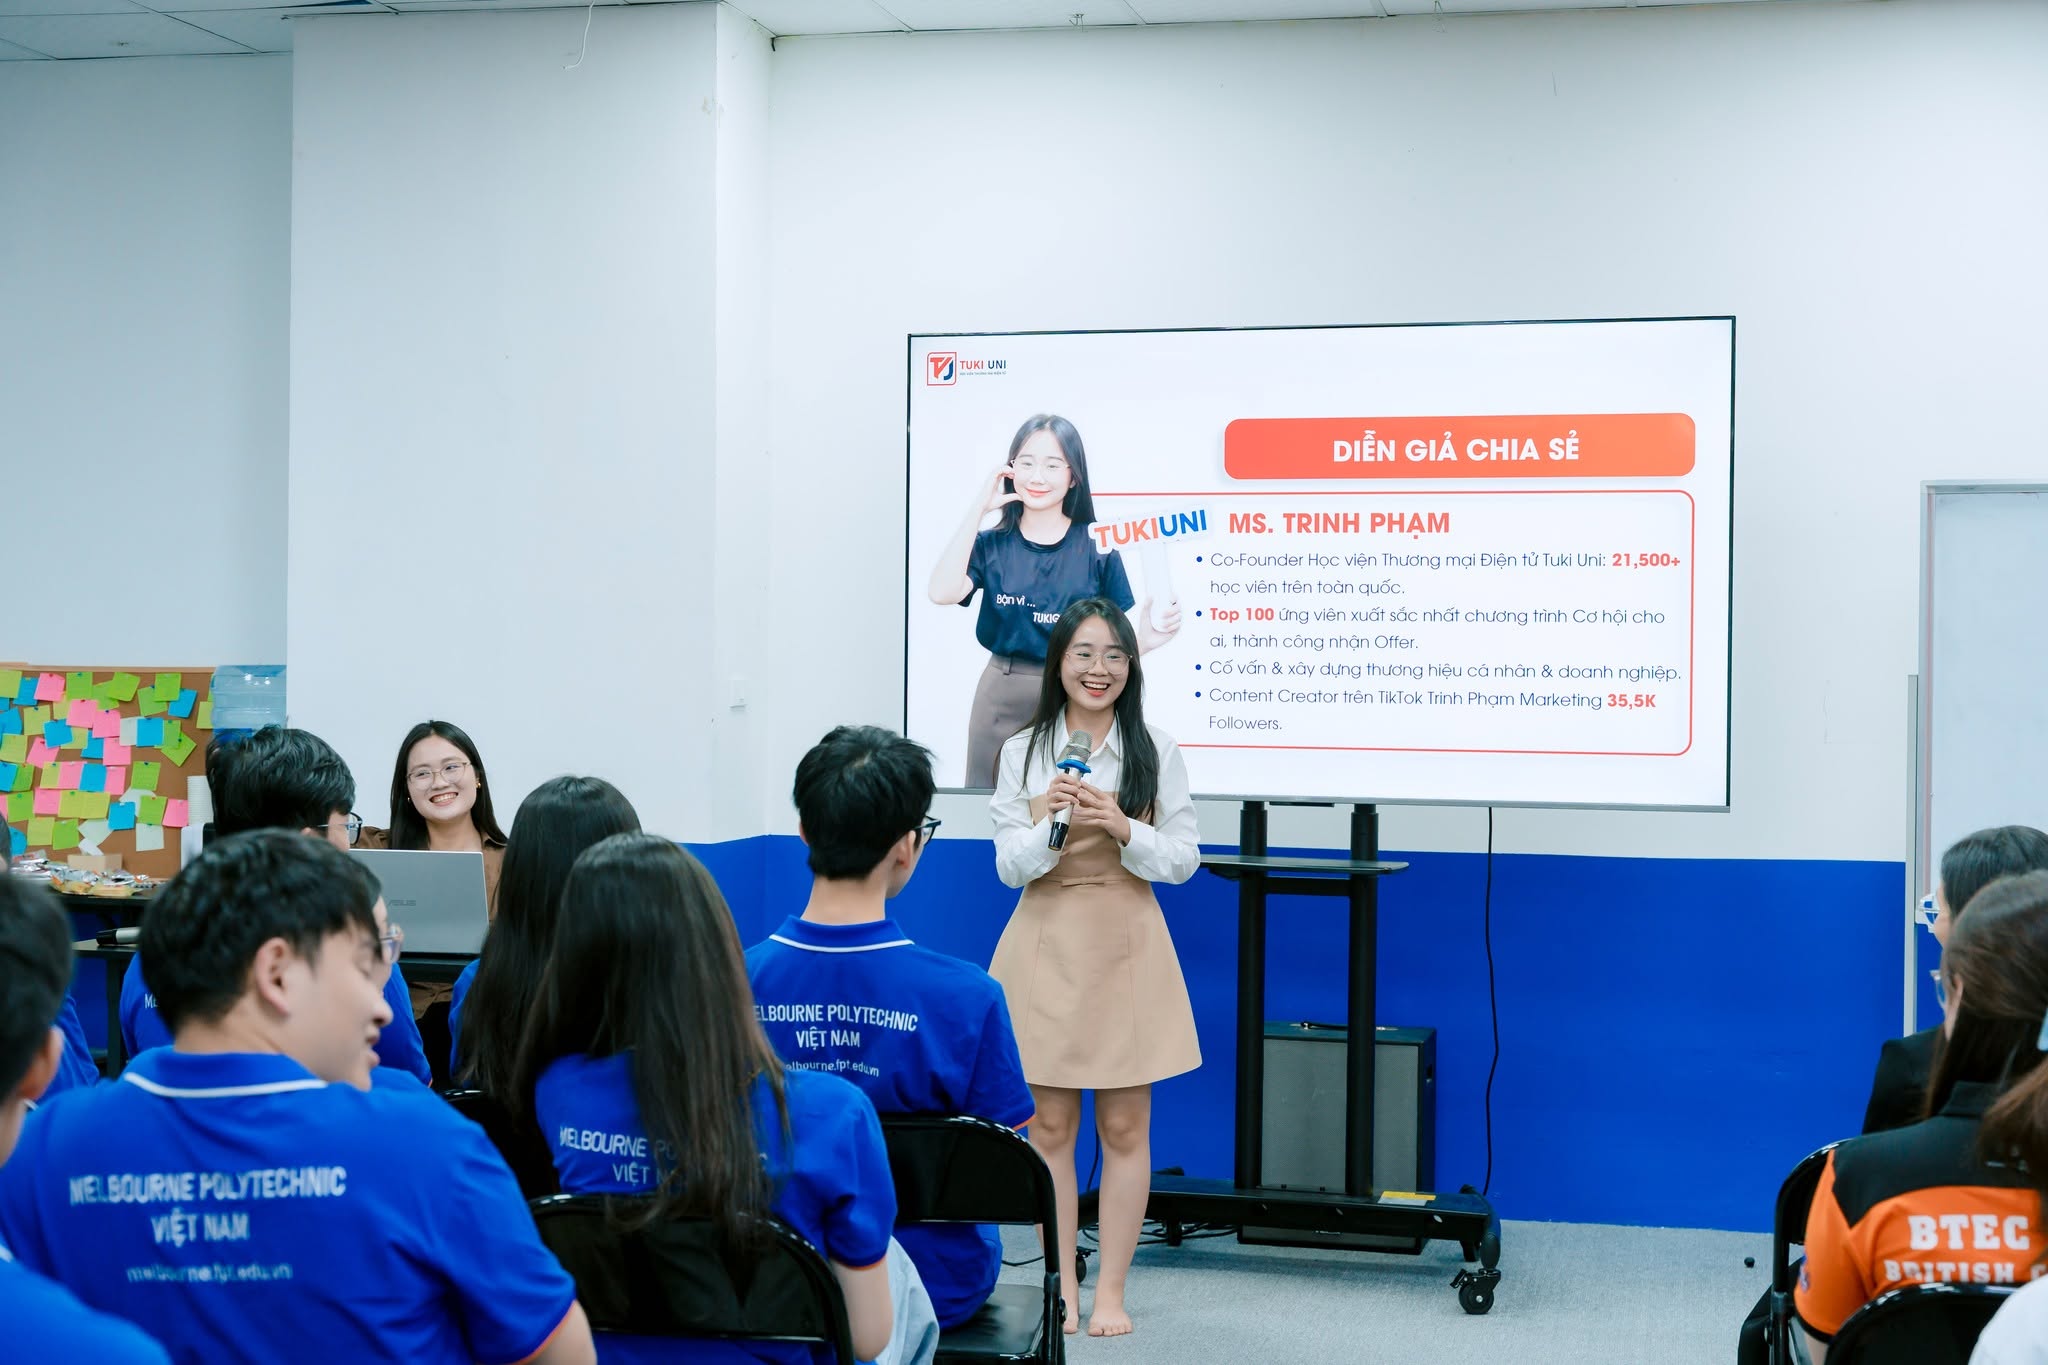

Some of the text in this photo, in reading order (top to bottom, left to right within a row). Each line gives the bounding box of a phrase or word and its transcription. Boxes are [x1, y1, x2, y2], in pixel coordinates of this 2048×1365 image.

[959, 359, 1007, 370] TUKI UNI
[1333, 429, 1579, 462] DIỄN GIẢ CHIA SẺ
[1094, 509, 1207, 548] TUKIUNI
[1229, 512, 1449, 539] MS. TRINH PHẠM
[1211, 552, 1680, 570] Co-Founder Học viện Thương mại Điện tử Tuki Uni: 21,500+
[1211, 579, 1404, 596] học viên trên toàn quốc.
[1210, 607, 1665, 626] Top 100 ứng viên xuất sắc nhất chương trình Cơ hội cho
[1210, 634, 1418, 651] ai, thành công nhận Offer.
[1210, 659, 1233, 674] Cố
[1237, 660, 1266, 674] vấn
[1288, 662, 1315, 678] xây
[1320, 662, 1361, 679] dựng
[1366, 663, 1423, 680] thương
[1429, 663, 1462, 679] hiệu
[1467, 664, 1488, 677] cá
[1495, 664, 1535, 678] nhân
[1559, 665, 1613, 679] doanh
[1619, 666, 1681, 682] nghiệp.
[1210, 688, 1656, 710] Content Creator trên TikTok Trinh Phạm Marketing 35,5K
[1210, 716, 1282, 730] Followers.
[752, 1004, 919, 1032] ELBOURNE POLYTECHNIC
[796, 1026, 861, 1050] VIỆT NAM
[612, 1161, 650, 1186] VIỆT
[69, 1166, 347, 1206] MELBOURNE POLYTECHNIC
[151, 1206, 250, 1248] VIỆT NAM
[1908, 1214, 2030, 1250] BTEC
[1884, 1260, 2015, 1283] BRITISH
